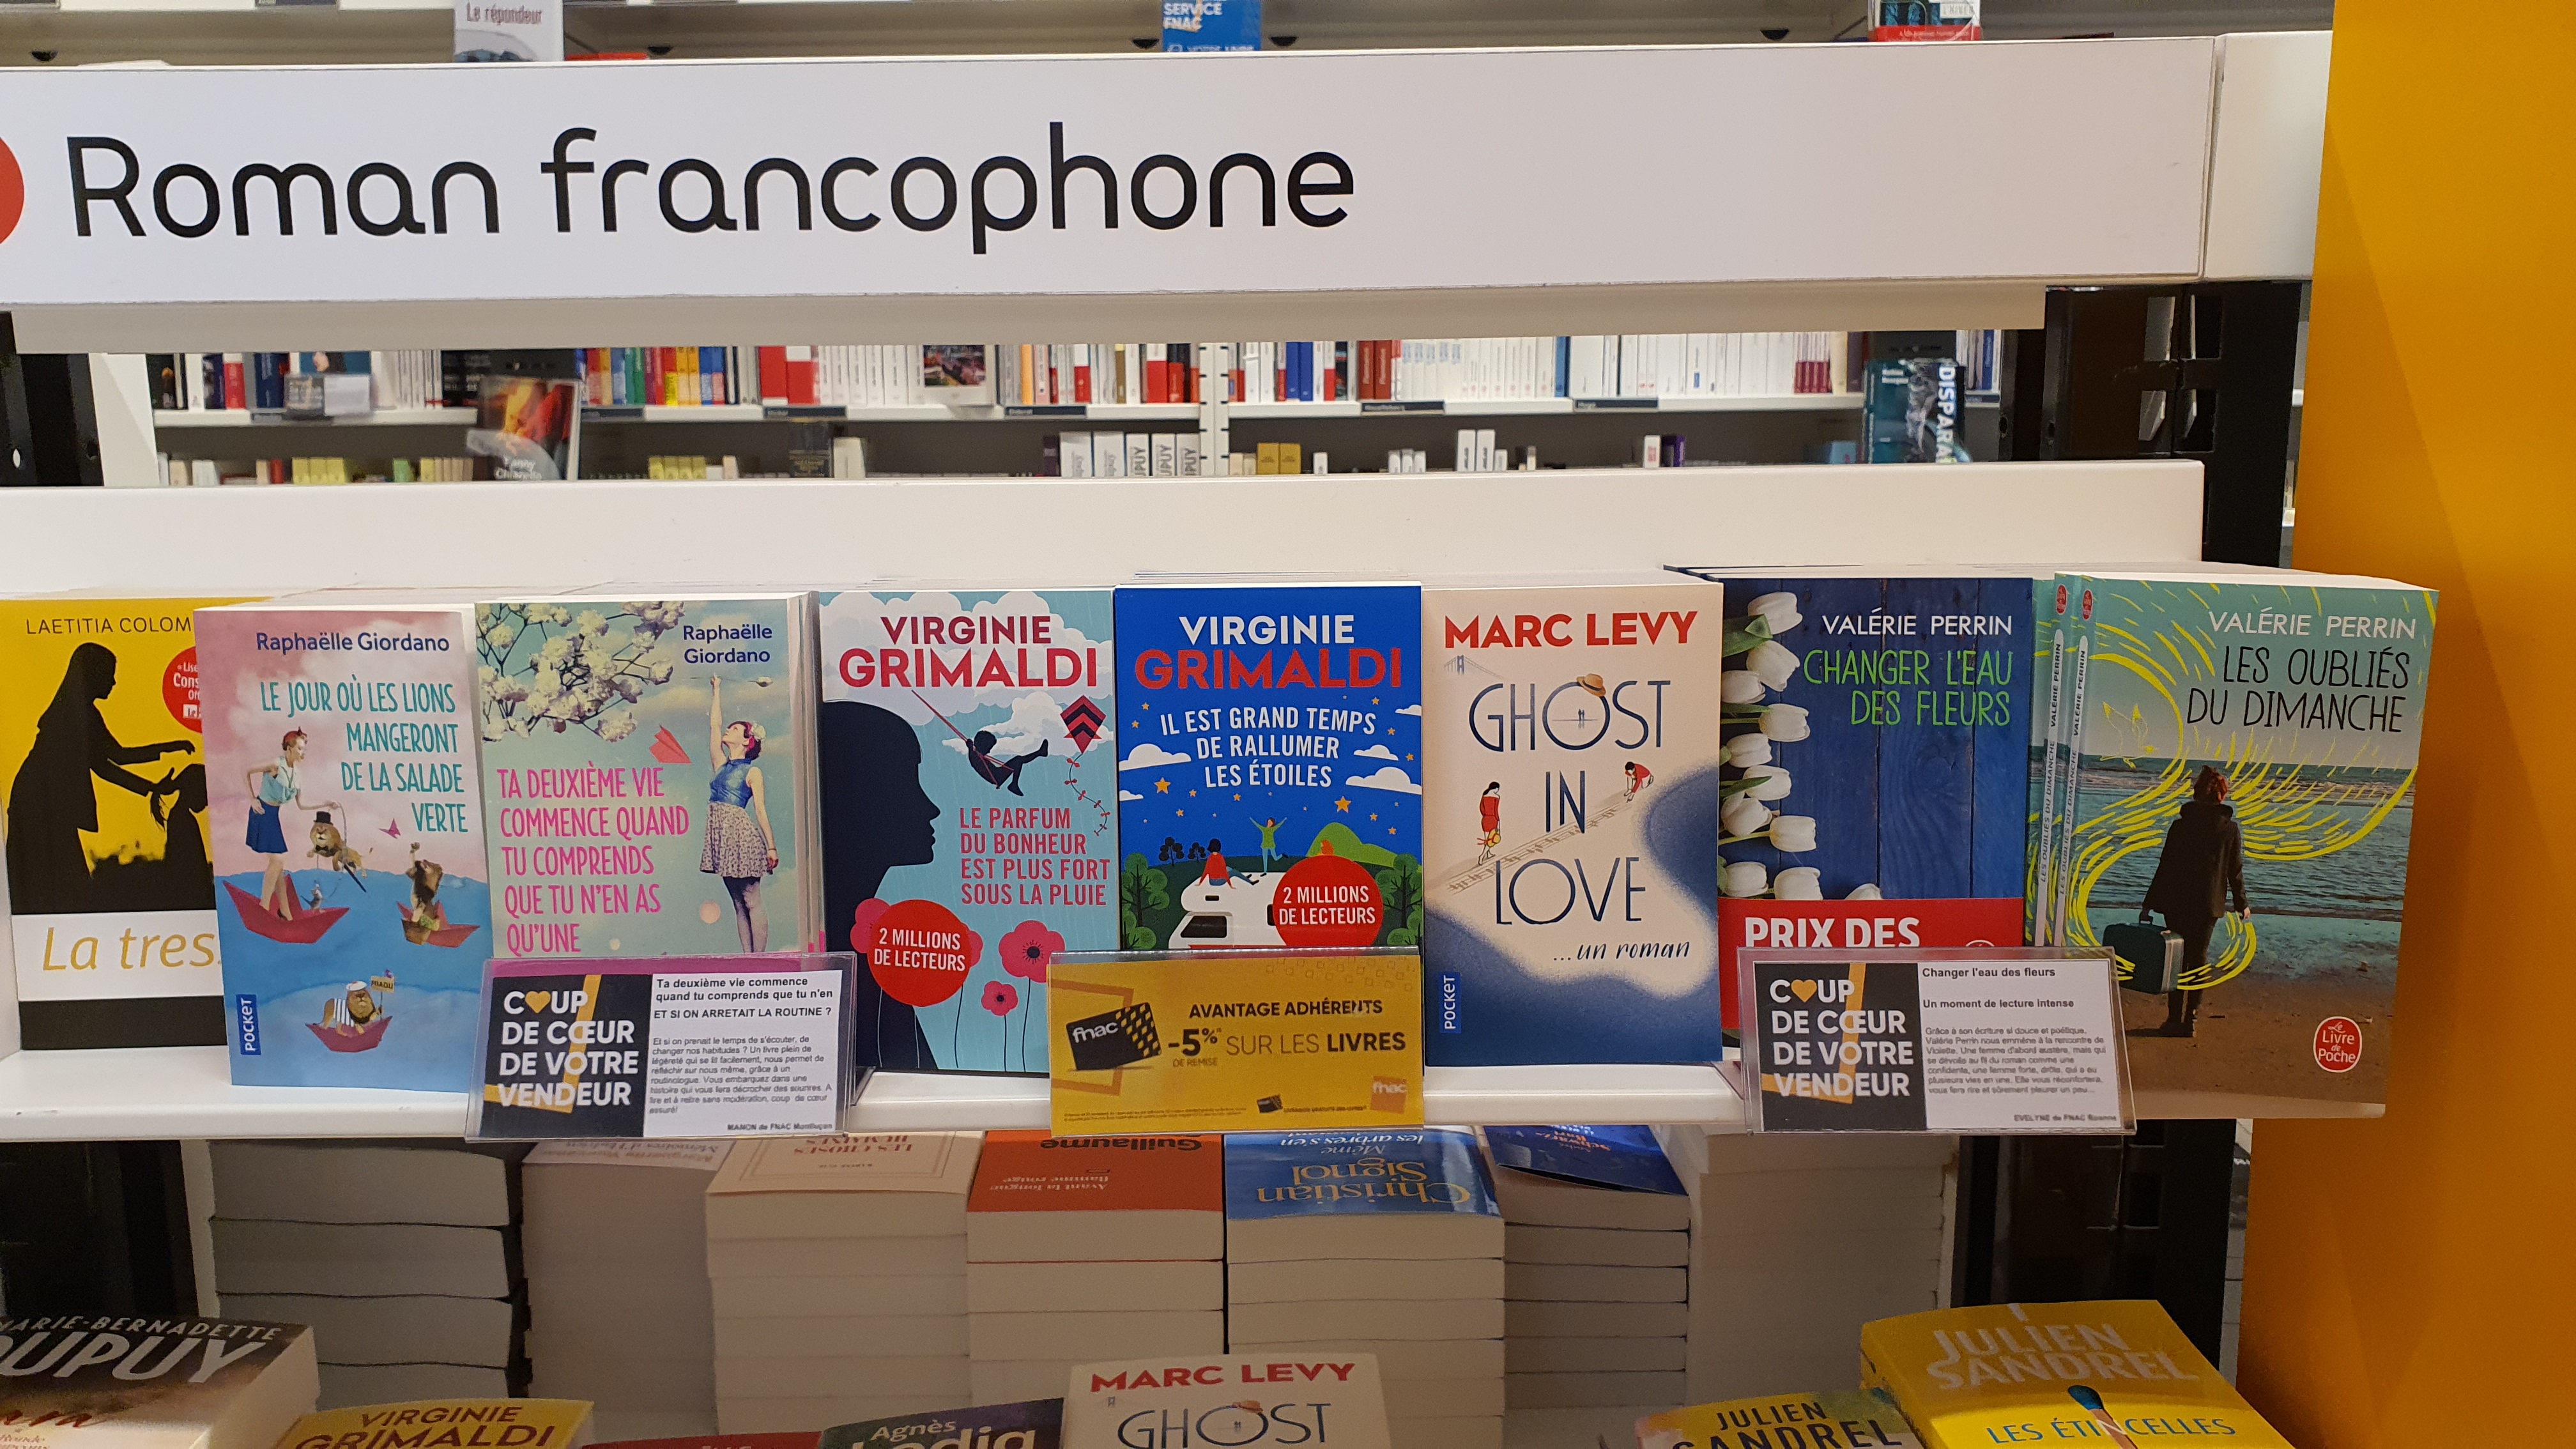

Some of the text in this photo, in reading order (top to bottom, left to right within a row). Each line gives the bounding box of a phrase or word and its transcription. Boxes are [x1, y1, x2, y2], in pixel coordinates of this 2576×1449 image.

[1163, 3, 1223, 16] SERVICE
[1163, 17, 1202, 30] FNAC
[67, 121, 1354, 256] Roman francophone
[26, 617, 114, 634] LAETITIA
[683, 623, 773, 644] Raphaëlle
[880, 616, 1052, 645] VIRGINIE
[1178, 614, 1354, 645] VIRGINIE
[1445, 611, 1698, 648] MARC LEVY
[1822, 607, 2012, 636] VALÉRIE PERRIN
[2209, 606, 2416, 640] VALÉRIE PERRIN
[256, 632, 450, 656] Raphaëlle Giordano
[684, 647, 771, 664] Giordano
[839, 647, 1097, 688] GRIMALDI
[1135, 647, 1401, 689] GRIMALDI
[1804, 649, 2014, 686] CHANGER L'EAU
[2223, 645, 2411, 689] LES OUBLIÉS
[260, 673, 456, 717] LE JOUR OÙ LES LIONS
[1469, 680, 1671, 753] GHOST
[1850, 690, 2011, 726] DES FLEURS
[2187, 687, 2407, 733] DU DIMANCHE
[1160, 706, 1377, 736] IL EST GRAND TEMPS
[346, 722, 459, 753] MANGERONT
[1196, 735, 1339, 760] DE RALLUMER
[341, 762, 465, 793] DE LA SALADE
[497, 760, 665, 800] TA DEUXIÈME VIE
[1204, 758, 1332, 788] LES ÉTOILES
[1545, 770, 1586, 834] IN
[411, 802, 468, 832] VERTE
[500, 805, 689, 841] COMMENCE QUAND
[960, 807, 1071, 829] LE PARFUM
[960, 832, 1087, 855] DU BONHEUR
[502, 845, 654, 876] TU COMPRENDS
[961, 858, 1110, 880] EST PLUS FORT
[505, 883, 662, 919] QUE TU N'EN AS
[961, 883, 1107, 906] SOUS LA PLUIE
[1283, 885, 1370, 904] 2 MILLIONS
[1496, 857, 1646, 925] LOVE
[1279, 906, 1376, 926] DE LECTEURS
[507, 922, 581, 957] QU'UNE
[879, 928, 962, 951] 2 MILLIONS
[1745, 917, 1920, 947] PRIX DES
[43, 926, 98, 971] La
[873, 948, 966, 972] DE LECTEURS
[1616, 940, 1690, 960] roman
[657, 977, 808, 988] Ta deuxième vie commence
[1922, 967, 2056, 979] Changer l'eau des fleurs
[656, 988, 833, 1002] quand tu comprends que tu n'en
[1188, 997, 1383, 1018] AVANTAGE ADHÉRENTS
[1923, 999, 2074, 1008] Un moment de lecture intense
[654, 1007, 823, 1019] ET SI ON ARRETAIT LA ROUTINE
[1772, 1009, 1906, 1034] DE CŒUR
[502, 1020, 635, 1045] DE CŒUR
[1072, 1022, 1119, 1043] fnac
[2322, 1029, 2355, 1045] Livre
[2328, 1022, 2346, 1033] Le
[1226, 1034, 1273, 1056] SUR
[1280, 1034, 1320, 1055] LES
[1327, 1032, 1406, 1053] LIVRES
[1774, 1041, 1914, 1066] DE VOTRE
[2318, 1048, 2356, 1063] Poche
[2331, 1044, 2342, 1052] de
[499, 1050, 639, 1076] DE VOTRE
[496, 1082, 631, 1107] VENDEUR
[1774, 1072, 1910, 1098] VENDEUR
[1040, 1138, 1203, 1151] Guillaume
[1321, 1144, 1386, 1155] Même
[1324, 1134, 1424, 1146] les arbres
[1292, 1157, 1428, 1186] Signol
[1257, 1181, 1471, 1204] Christian
[1933, 1323, 2132, 1365] JULIEN
[0, 1331, 266, 1383] UPUY
[1090, 1363, 1356, 1393] MARC LEVY
[1927, 1351, 2200, 1390] SANDREL
[362, 1406, 523, 1428] VIRGINIE
[1117, 1402, 1331, 1449] GHOST
[1717, 1402, 1828, 1431] JULIEN
[870, 1419, 958, 1443] Agnès
[1986, 1417, 2237, 1445] LES ÉTINCELLES
